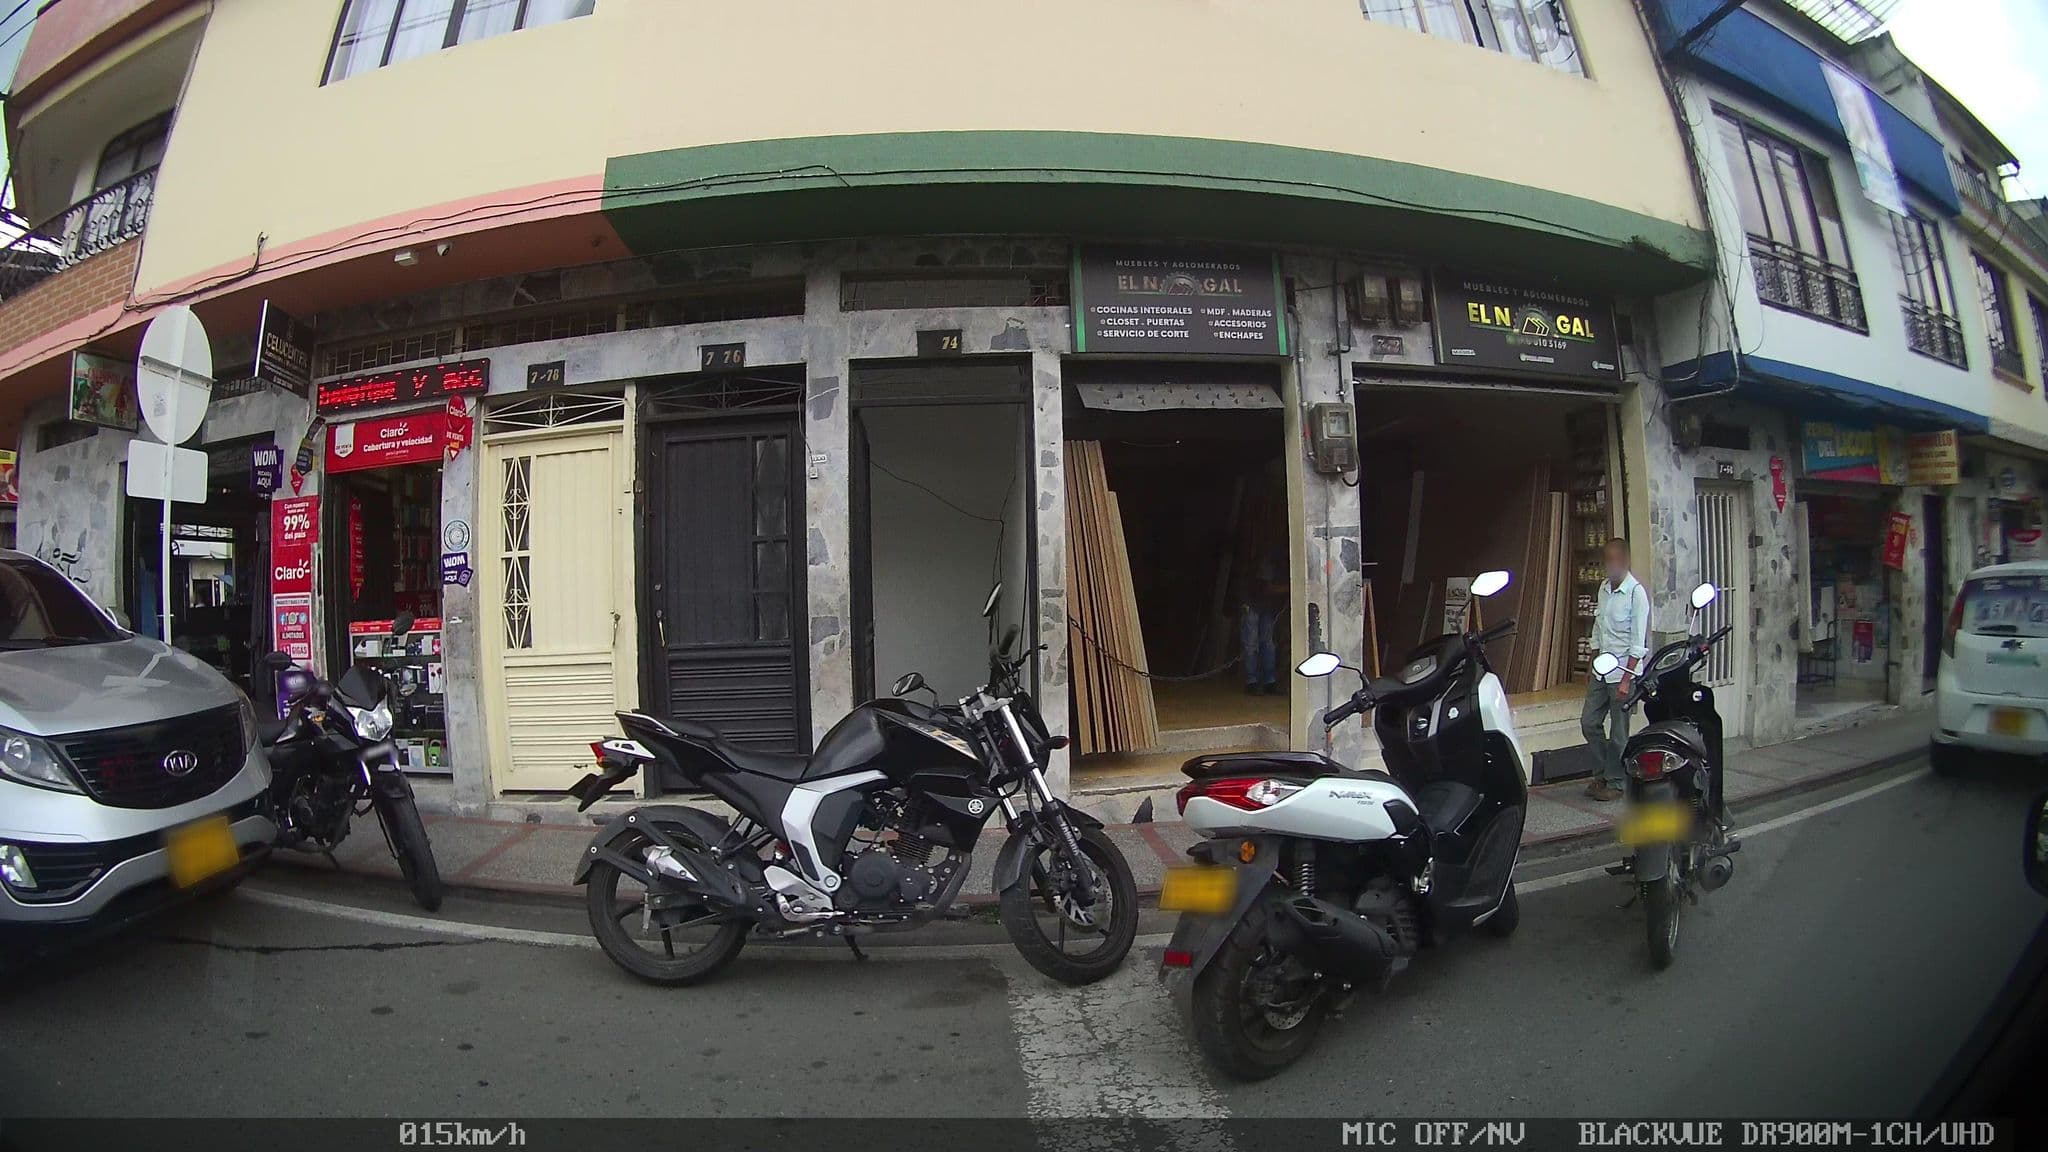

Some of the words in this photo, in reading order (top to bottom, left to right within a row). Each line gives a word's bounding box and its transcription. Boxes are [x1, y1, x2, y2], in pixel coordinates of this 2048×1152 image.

[1116, 259, 1159, 268] MUEBLES
[1172, 261, 1240, 271] AGLOMERADOS
[1118, 275, 1137, 290] EL
[1463, 282, 1509, 295] MUEBLES
[1097, 306, 1138, 315] COCINAS
[1140, 307, 1193, 315] INTEGRALES
[1207, 308, 1226, 316] MDF
[1232, 308, 1272, 318] MADERAS
[1467, 302, 1491, 324] EL
[1106, 318, 1139, 327] CLOSET
[1147, 318, 1184, 327] PUERTAS
[1214, 320, 1267, 329] ACCESORIOS
[1103, 330, 1145, 339] SERVICIO
[1147, 330, 1159, 339] DE
[1160, 330, 1189, 339] CORTE
[1219, 331, 1264, 340] ENCHAPES
[530, 368, 560, 384] 7-78
[380, 424, 407, 439] Claro
[363, 440, 395, 452] Cobertura
[401, 435, 433, 447] velocidad
[254, 450, 277, 467] WOM
[284, 514, 310, 532] 99%
[444, 555, 466, 568] WOM
[274, 563, 307, 580] Claro
[169, 754, 193, 770] KIA
